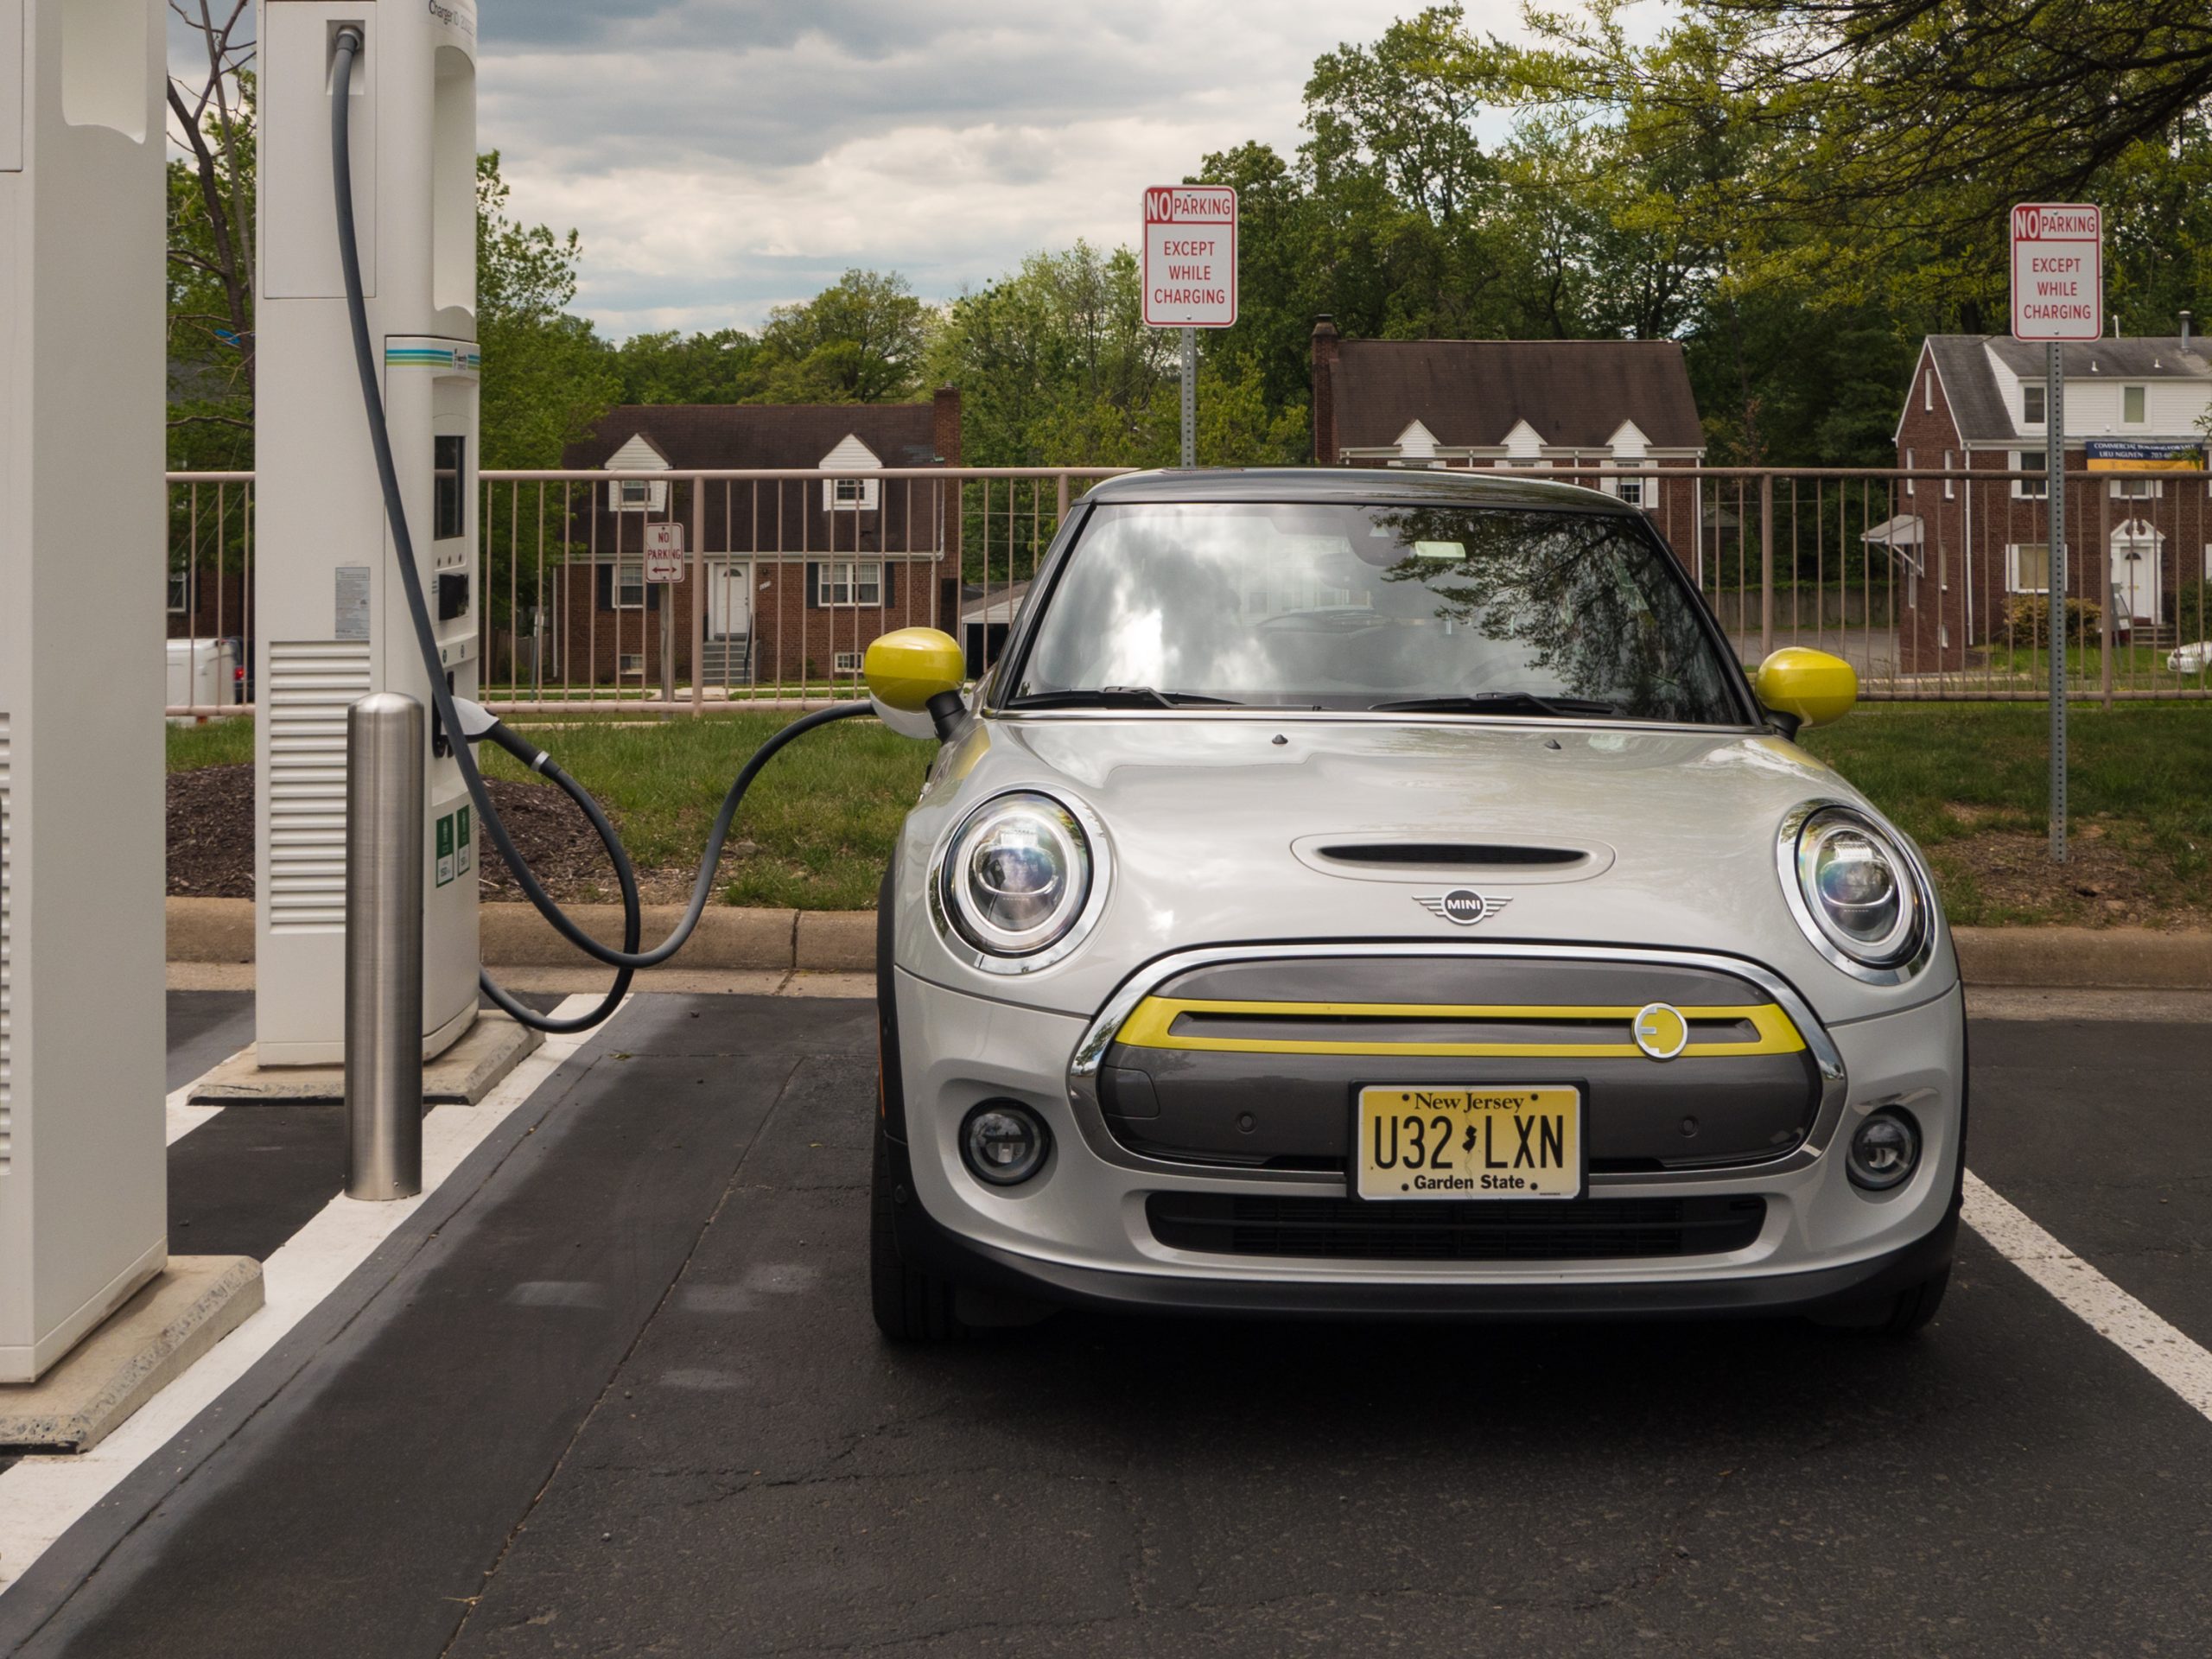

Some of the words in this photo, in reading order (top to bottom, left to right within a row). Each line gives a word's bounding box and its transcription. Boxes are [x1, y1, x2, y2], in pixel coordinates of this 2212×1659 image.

[1147, 192, 1173, 221] NO
[1174, 198, 1230, 215] PARKING
[2016, 210, 2039, 238] NO
[2042, 216, 2095, 232] PARKING
[1164, 241, 1215, 256] EXCEPT
[1169, 265, 1211, 280] WHILE
[2032, 258, 2081, 272] EXCEPT
[1154, 289, 1224, 304] CHARGING
[2037, 282, 2077, 296] WHILE
[2024, 304, 2091, 320] CHARGING
[658, 532, 670, 543] NO
[647, 549, 681, 560] PARKING
[1446, 899, 1481, 910] MINI
[1414, 1093, 1461, 1110] New
[1463, 1092, 1524, 1113] Jersey
[1374, 1116, 1453, 1169] U32
[1485, 1115, 1564, 1168] LXN
[1414, 1175, 1474, 1190] Garden
[1480, 1174, 1525, 1190] State
